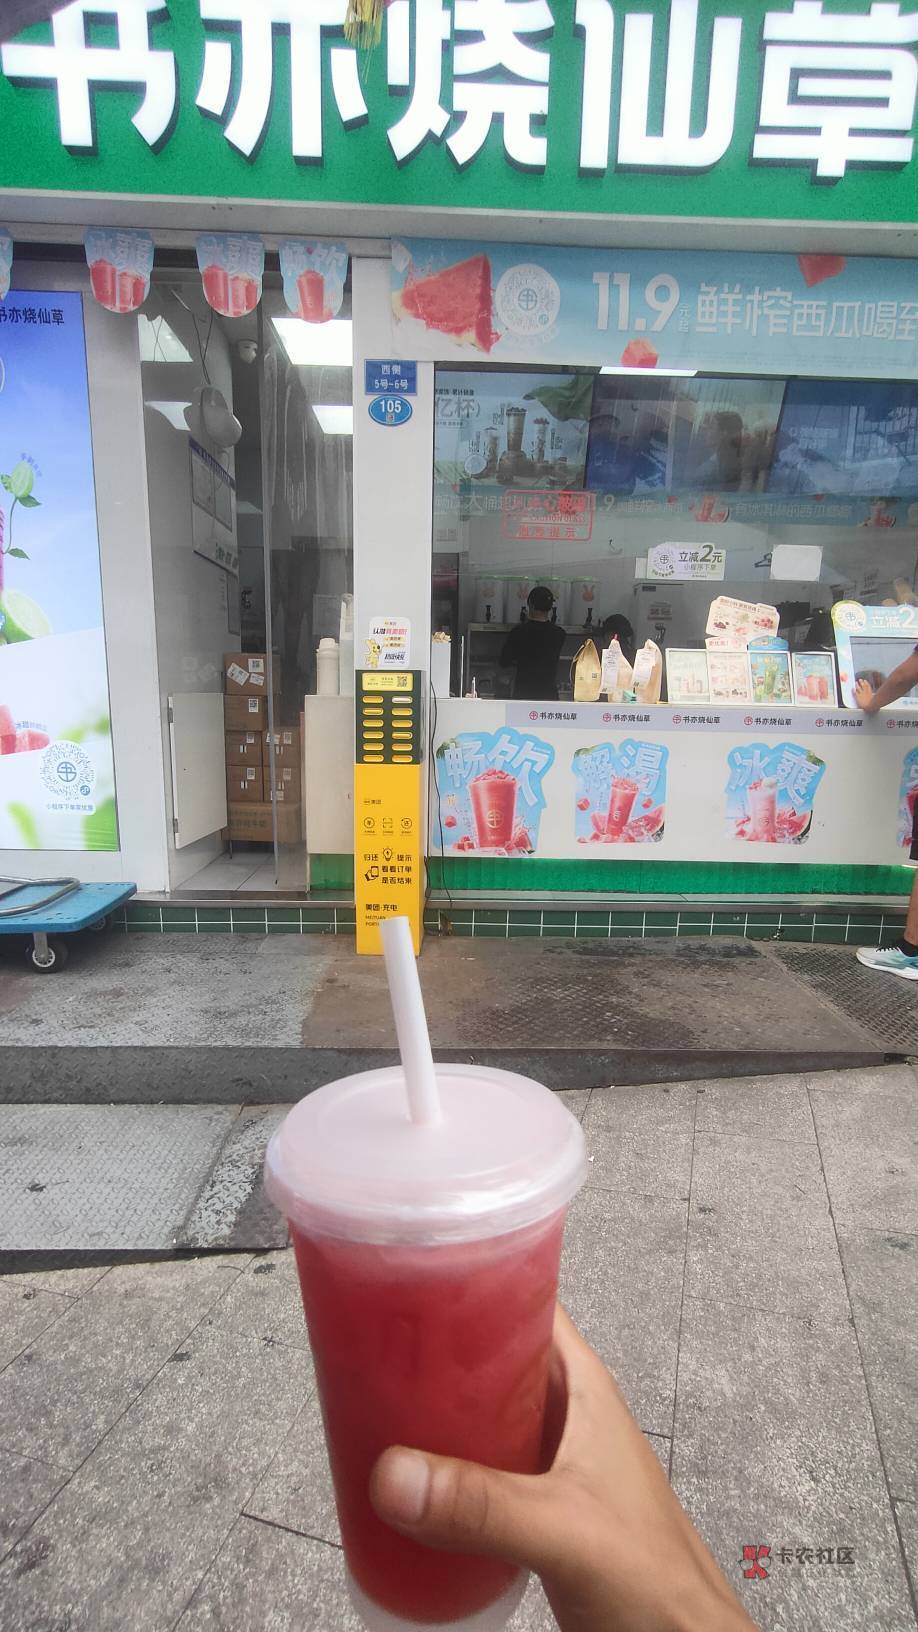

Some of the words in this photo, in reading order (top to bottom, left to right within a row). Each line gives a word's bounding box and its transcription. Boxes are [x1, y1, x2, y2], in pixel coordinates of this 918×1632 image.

[0, 0, 916, 177] 书亦烧仙草
[593, 271, 680, 332] 11.9
[696, 283, 918, 341] 鲜榨西瓜喝至
[381, 364, 401, 375] 西侧
[380, 399, 402, 413] 105
[678, 544, 723, 563] 立减2元
[539, 712, 577, 721] 书亦烧仙草
[613, 713, 650, 722] 书亦烧仙草
[683, 715, 720, 724] 书亦烧仙草
[754, 717, 792, 726] 书亦烧仙草
[825, 719, 863, 727] 书亦烧仙草
[445, 734, 549, 807] 畅饮
[729, 749, 820, 806] 冰爽
[382, 865, 411, 873] 看看订单
